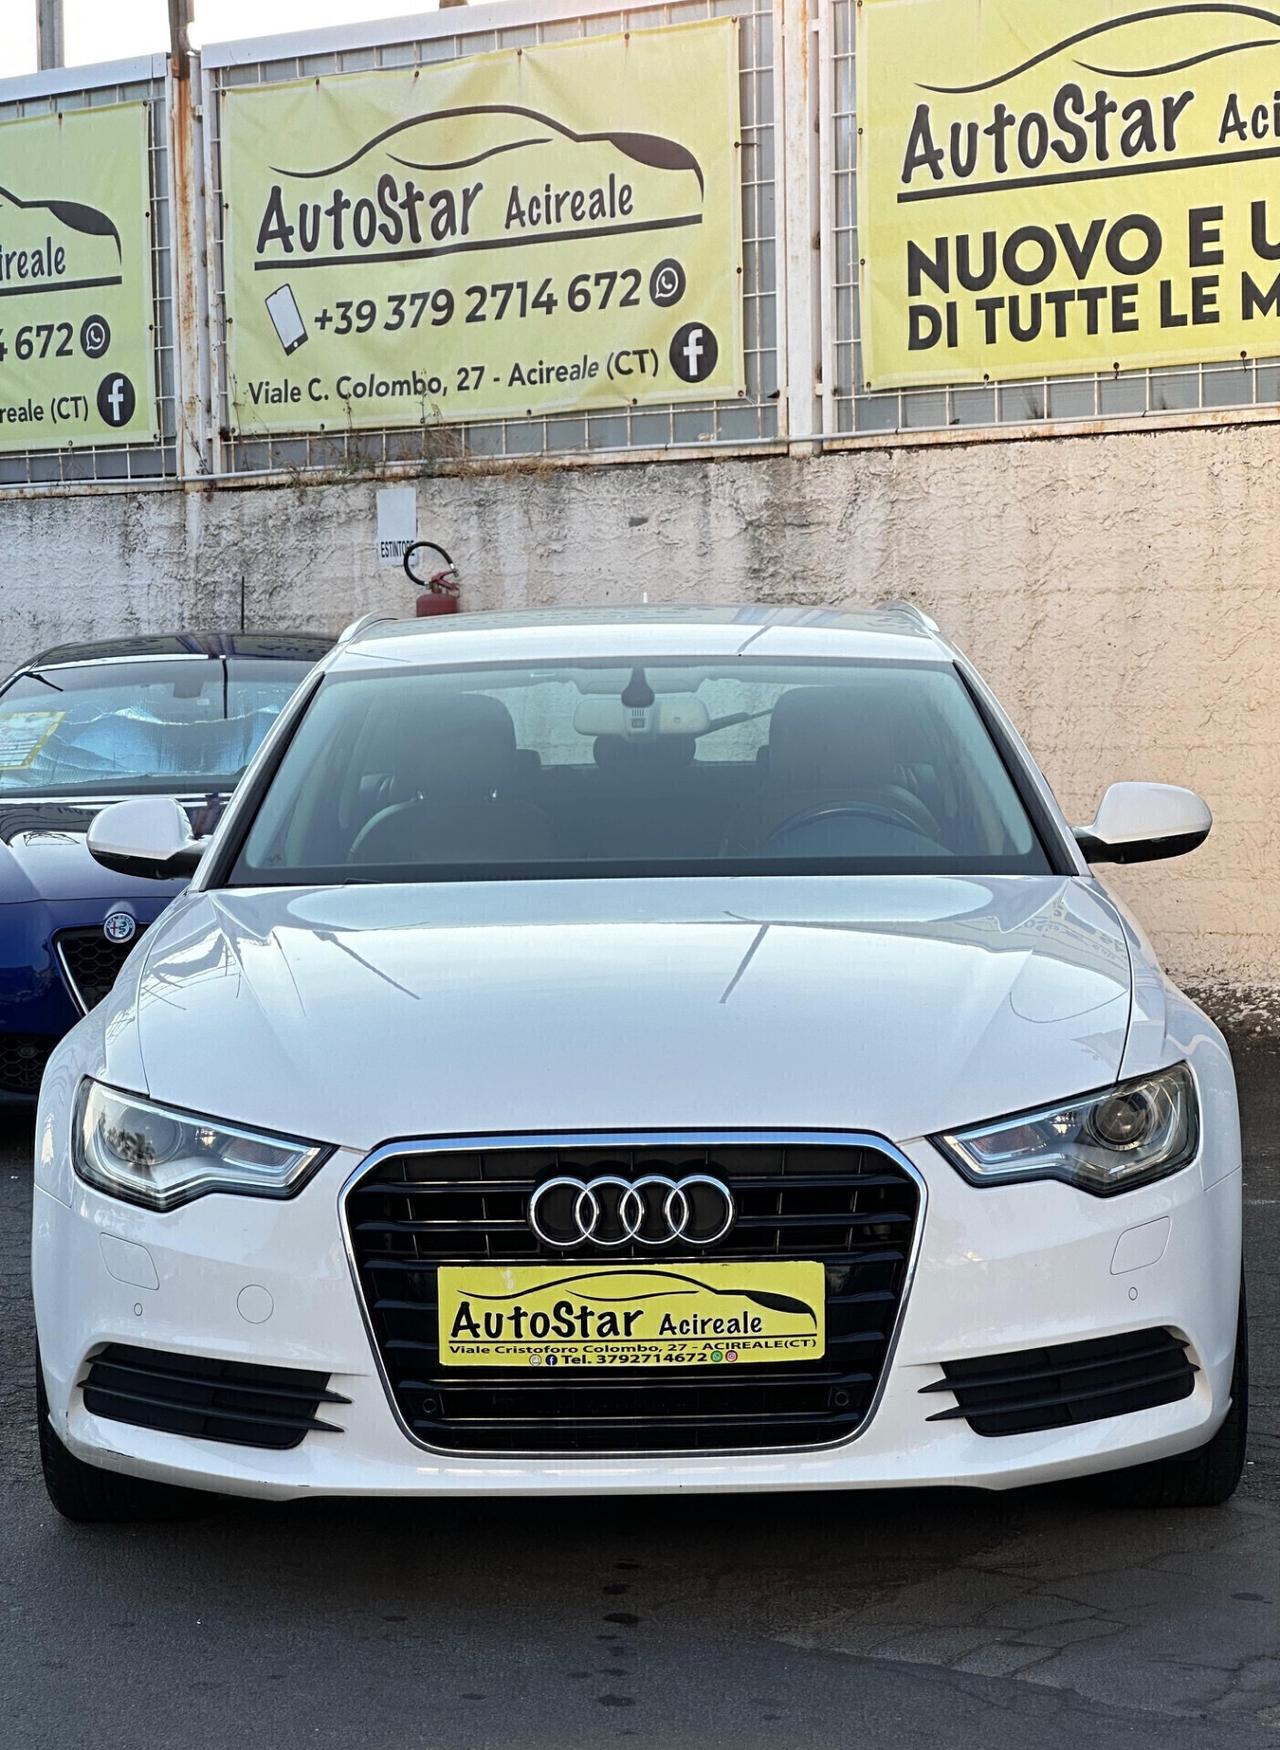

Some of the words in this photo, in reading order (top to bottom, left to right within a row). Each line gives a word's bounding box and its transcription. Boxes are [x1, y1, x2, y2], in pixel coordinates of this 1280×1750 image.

[901, 83, 1194, 184] AutoStar
[257, 173, 483, 254] AutoStar
[504, 172, 634, 230] Acireale
[907, 213, 1162, 297] NUOVO
[1188, 205, 1224, 268] E
[314, 299, 376, 335] +39
[383, 288, 455, 331] 379
[465, 278, 558, 323] 2714
[567, 268, 642, 313] 672
[907, 301, 958, 351] DI
[976, 283, 1139, 345] TUTTE
[1160, 274, 1220, 329] LE
[1242, 271, 1280, 321] M
[15, 322, 74, 360] 672
[248, 379, 301, 404] Viale
[307, 377, 329, 401] C.
[335, 370, 448, 401] Colombo,
[456, 366, 487, 391] 27
[508, 354, 599, 387] Acireale
[606, 348, 659, 380] (CT)
[51, 395, 89, 424] (CT)
[381, 540, 415, 558] ESTINTOE
[451, 1301, 644, 1339] AutoStar
[659, 1310, 763, 1336] Acireale
[449, 1345, 491, 1354] Viale
[494, 1344, 579, 1354] Cristoforo
[582, 1343, 663, 1354] Colombo,
[667, 1343, 688, 1352] 27
[702, 1338, 817, 1350] ACIREALE(CT)
[561, 1354, 593, 1365] Tel.
[596, 1352, 708, 1364] 3792714672
